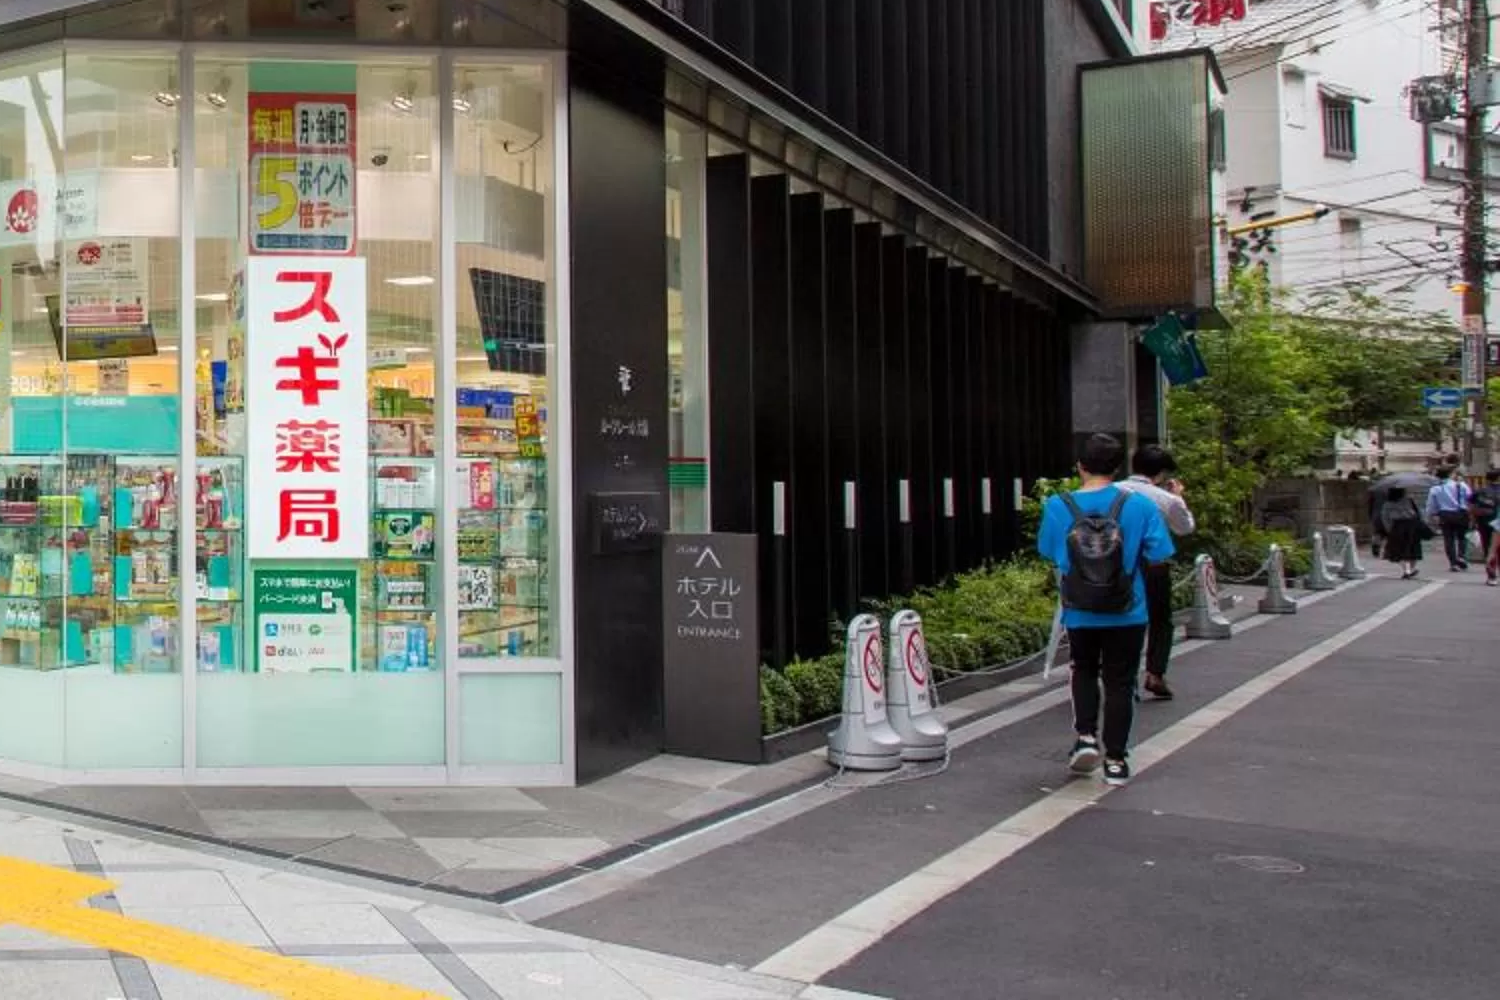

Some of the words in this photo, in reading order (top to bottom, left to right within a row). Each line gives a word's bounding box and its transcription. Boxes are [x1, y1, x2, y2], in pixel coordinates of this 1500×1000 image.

[257, 158, 298, 229] 5
[273, 270, 349, 543] スギ薬局
[676, 576, 741, 596] ホテル
[688, 600, 733, 619] 入口
[677, 625, 741, 640] ENTRANCE
